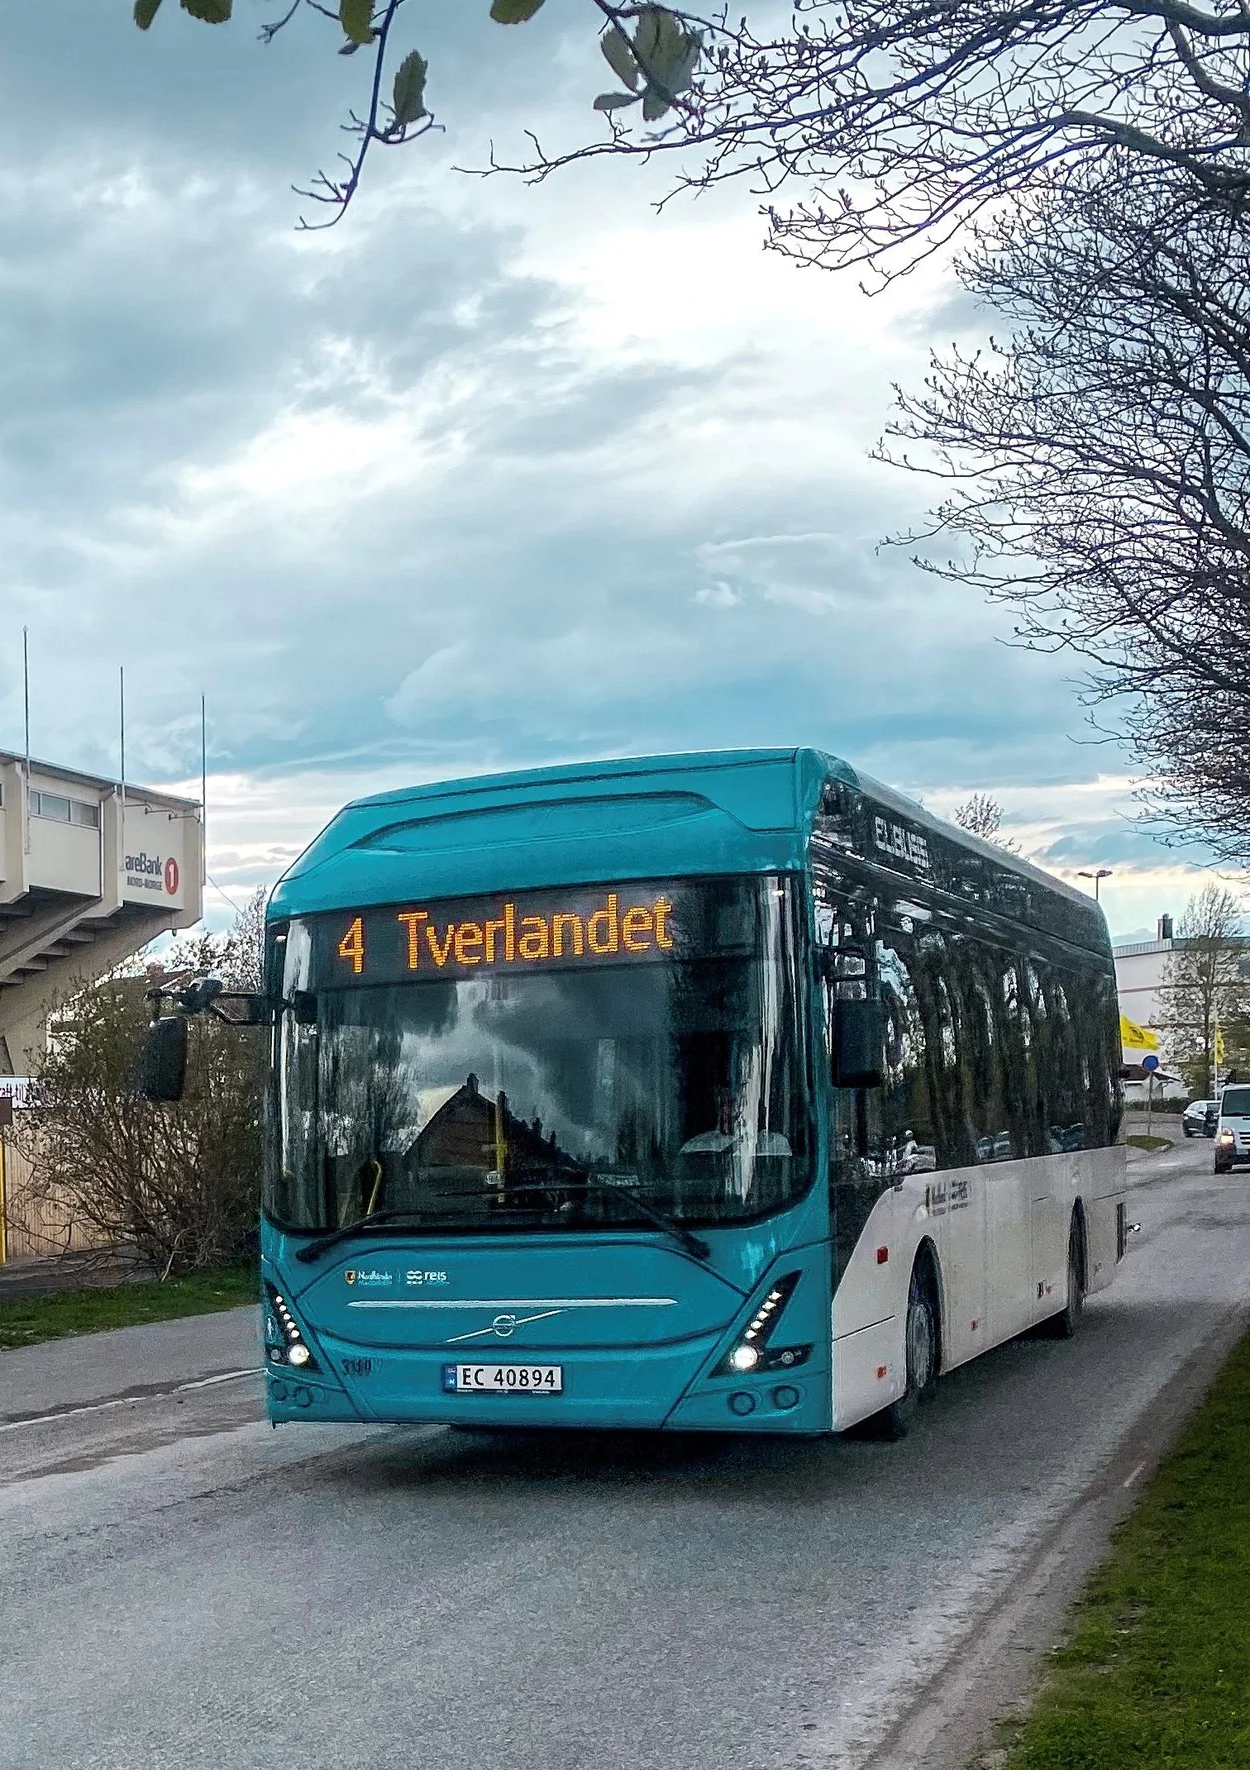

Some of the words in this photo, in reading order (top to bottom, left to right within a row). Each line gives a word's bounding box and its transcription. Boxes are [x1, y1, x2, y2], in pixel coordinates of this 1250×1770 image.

[125, 852, 163, 876] areBank
[338, 917, 364, 973] 4
[397, 893, 673, 970] Tverlandet
[462, 1368, 485, 1386] EC
[493, 1368, 555, 1387] 40894
